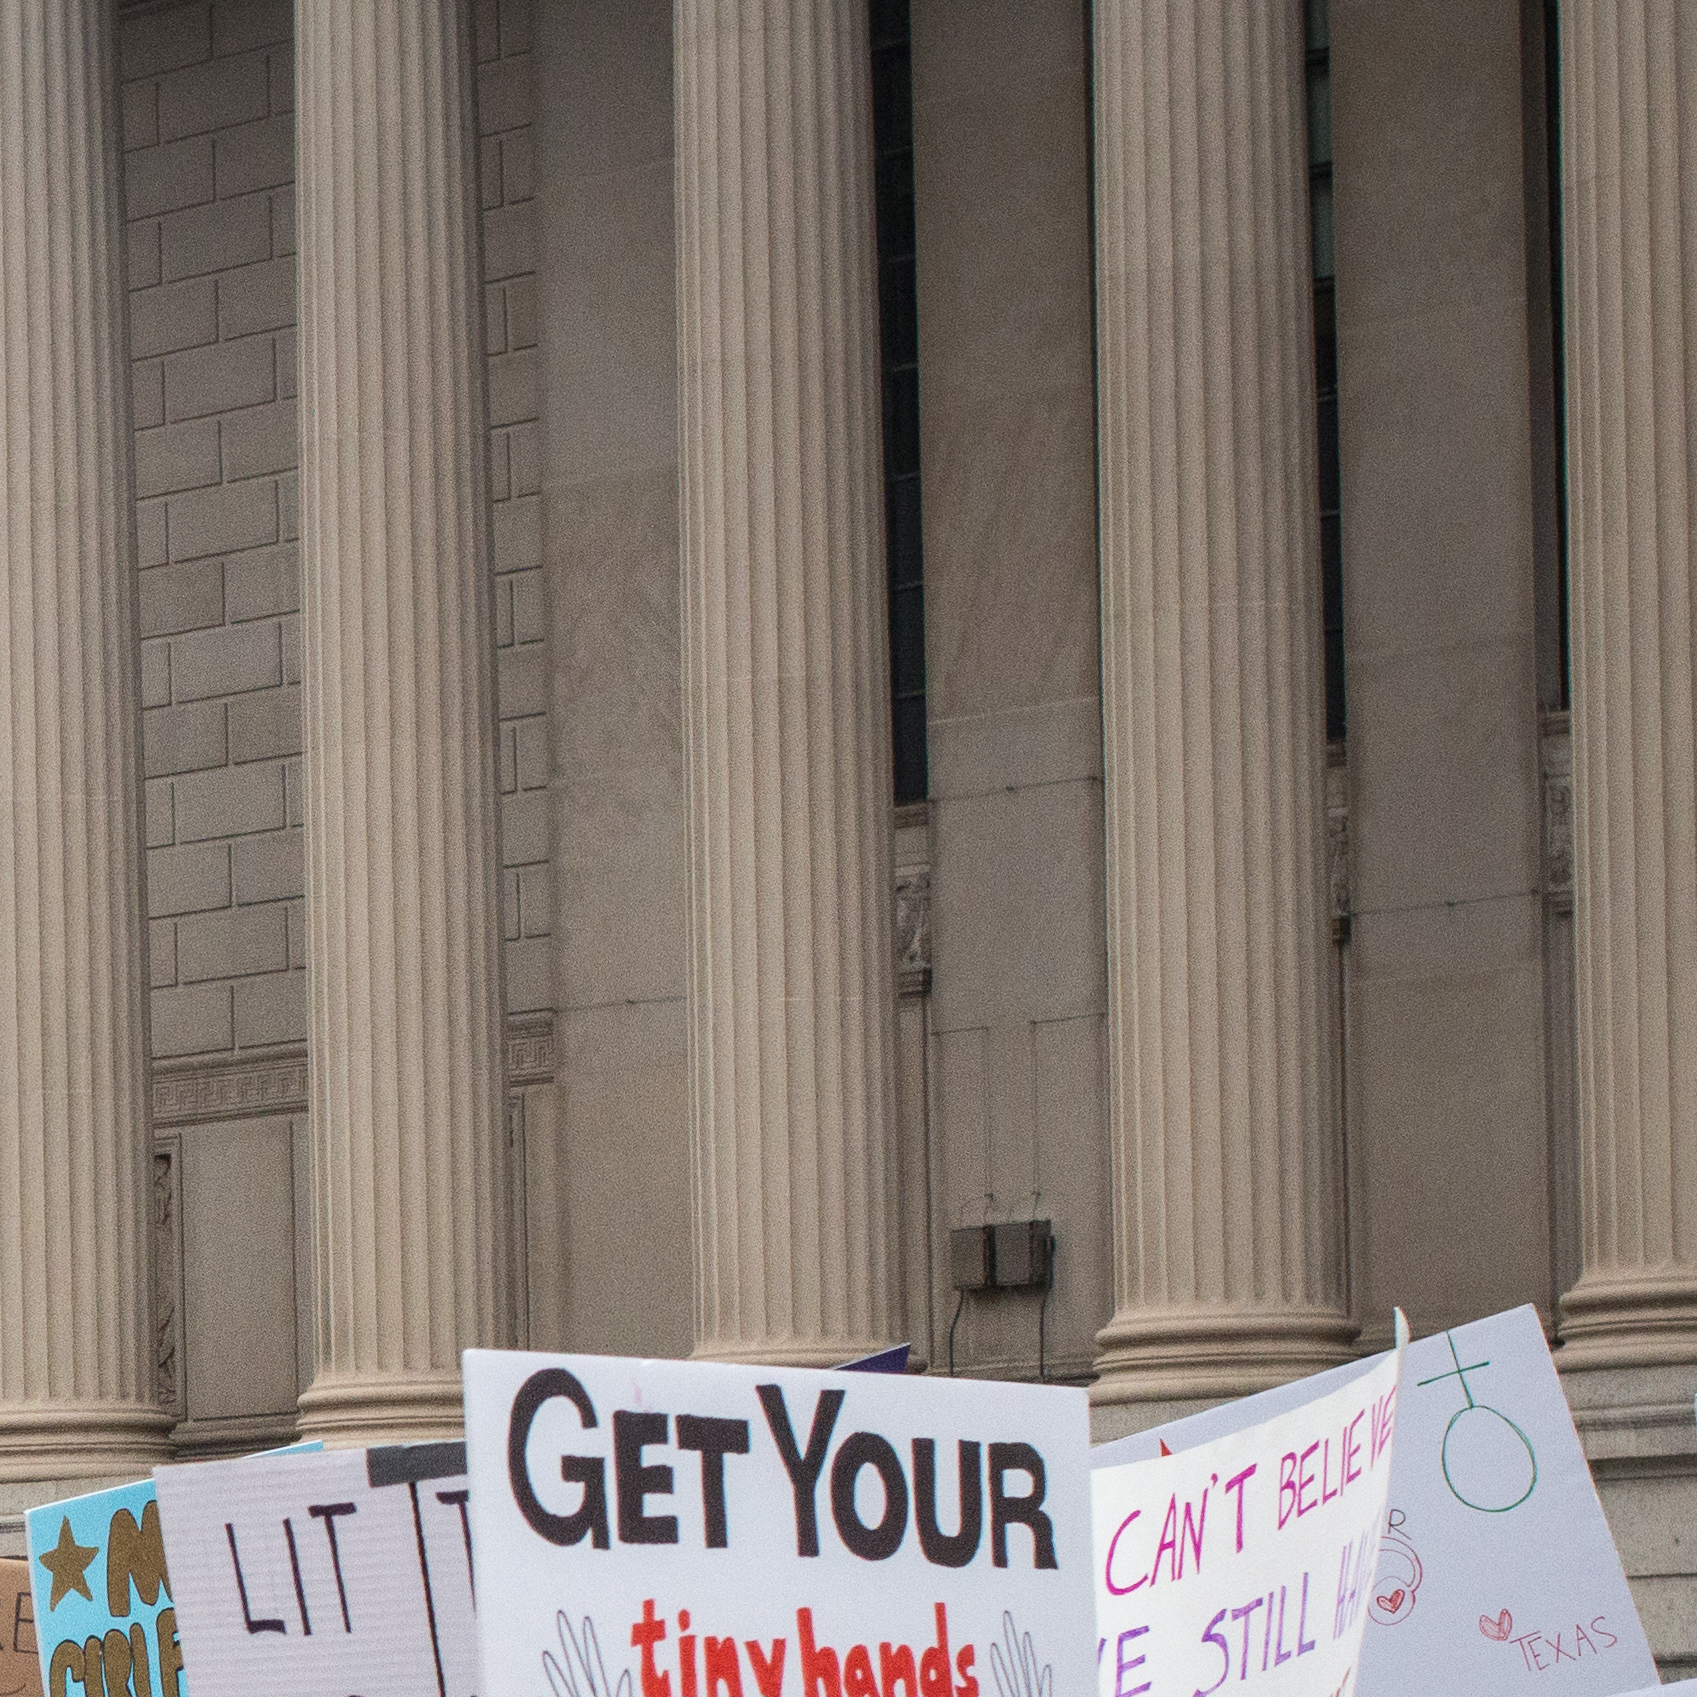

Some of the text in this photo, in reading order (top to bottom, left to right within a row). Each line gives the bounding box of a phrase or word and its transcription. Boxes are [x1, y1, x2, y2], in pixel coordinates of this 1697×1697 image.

[508, 1368, 1058, 1570] GET YOUR
[1104, 1384, 1397, 1596] CAN'T BELIEVE
[1509, 1616, 1618, 1671] TEXAS
